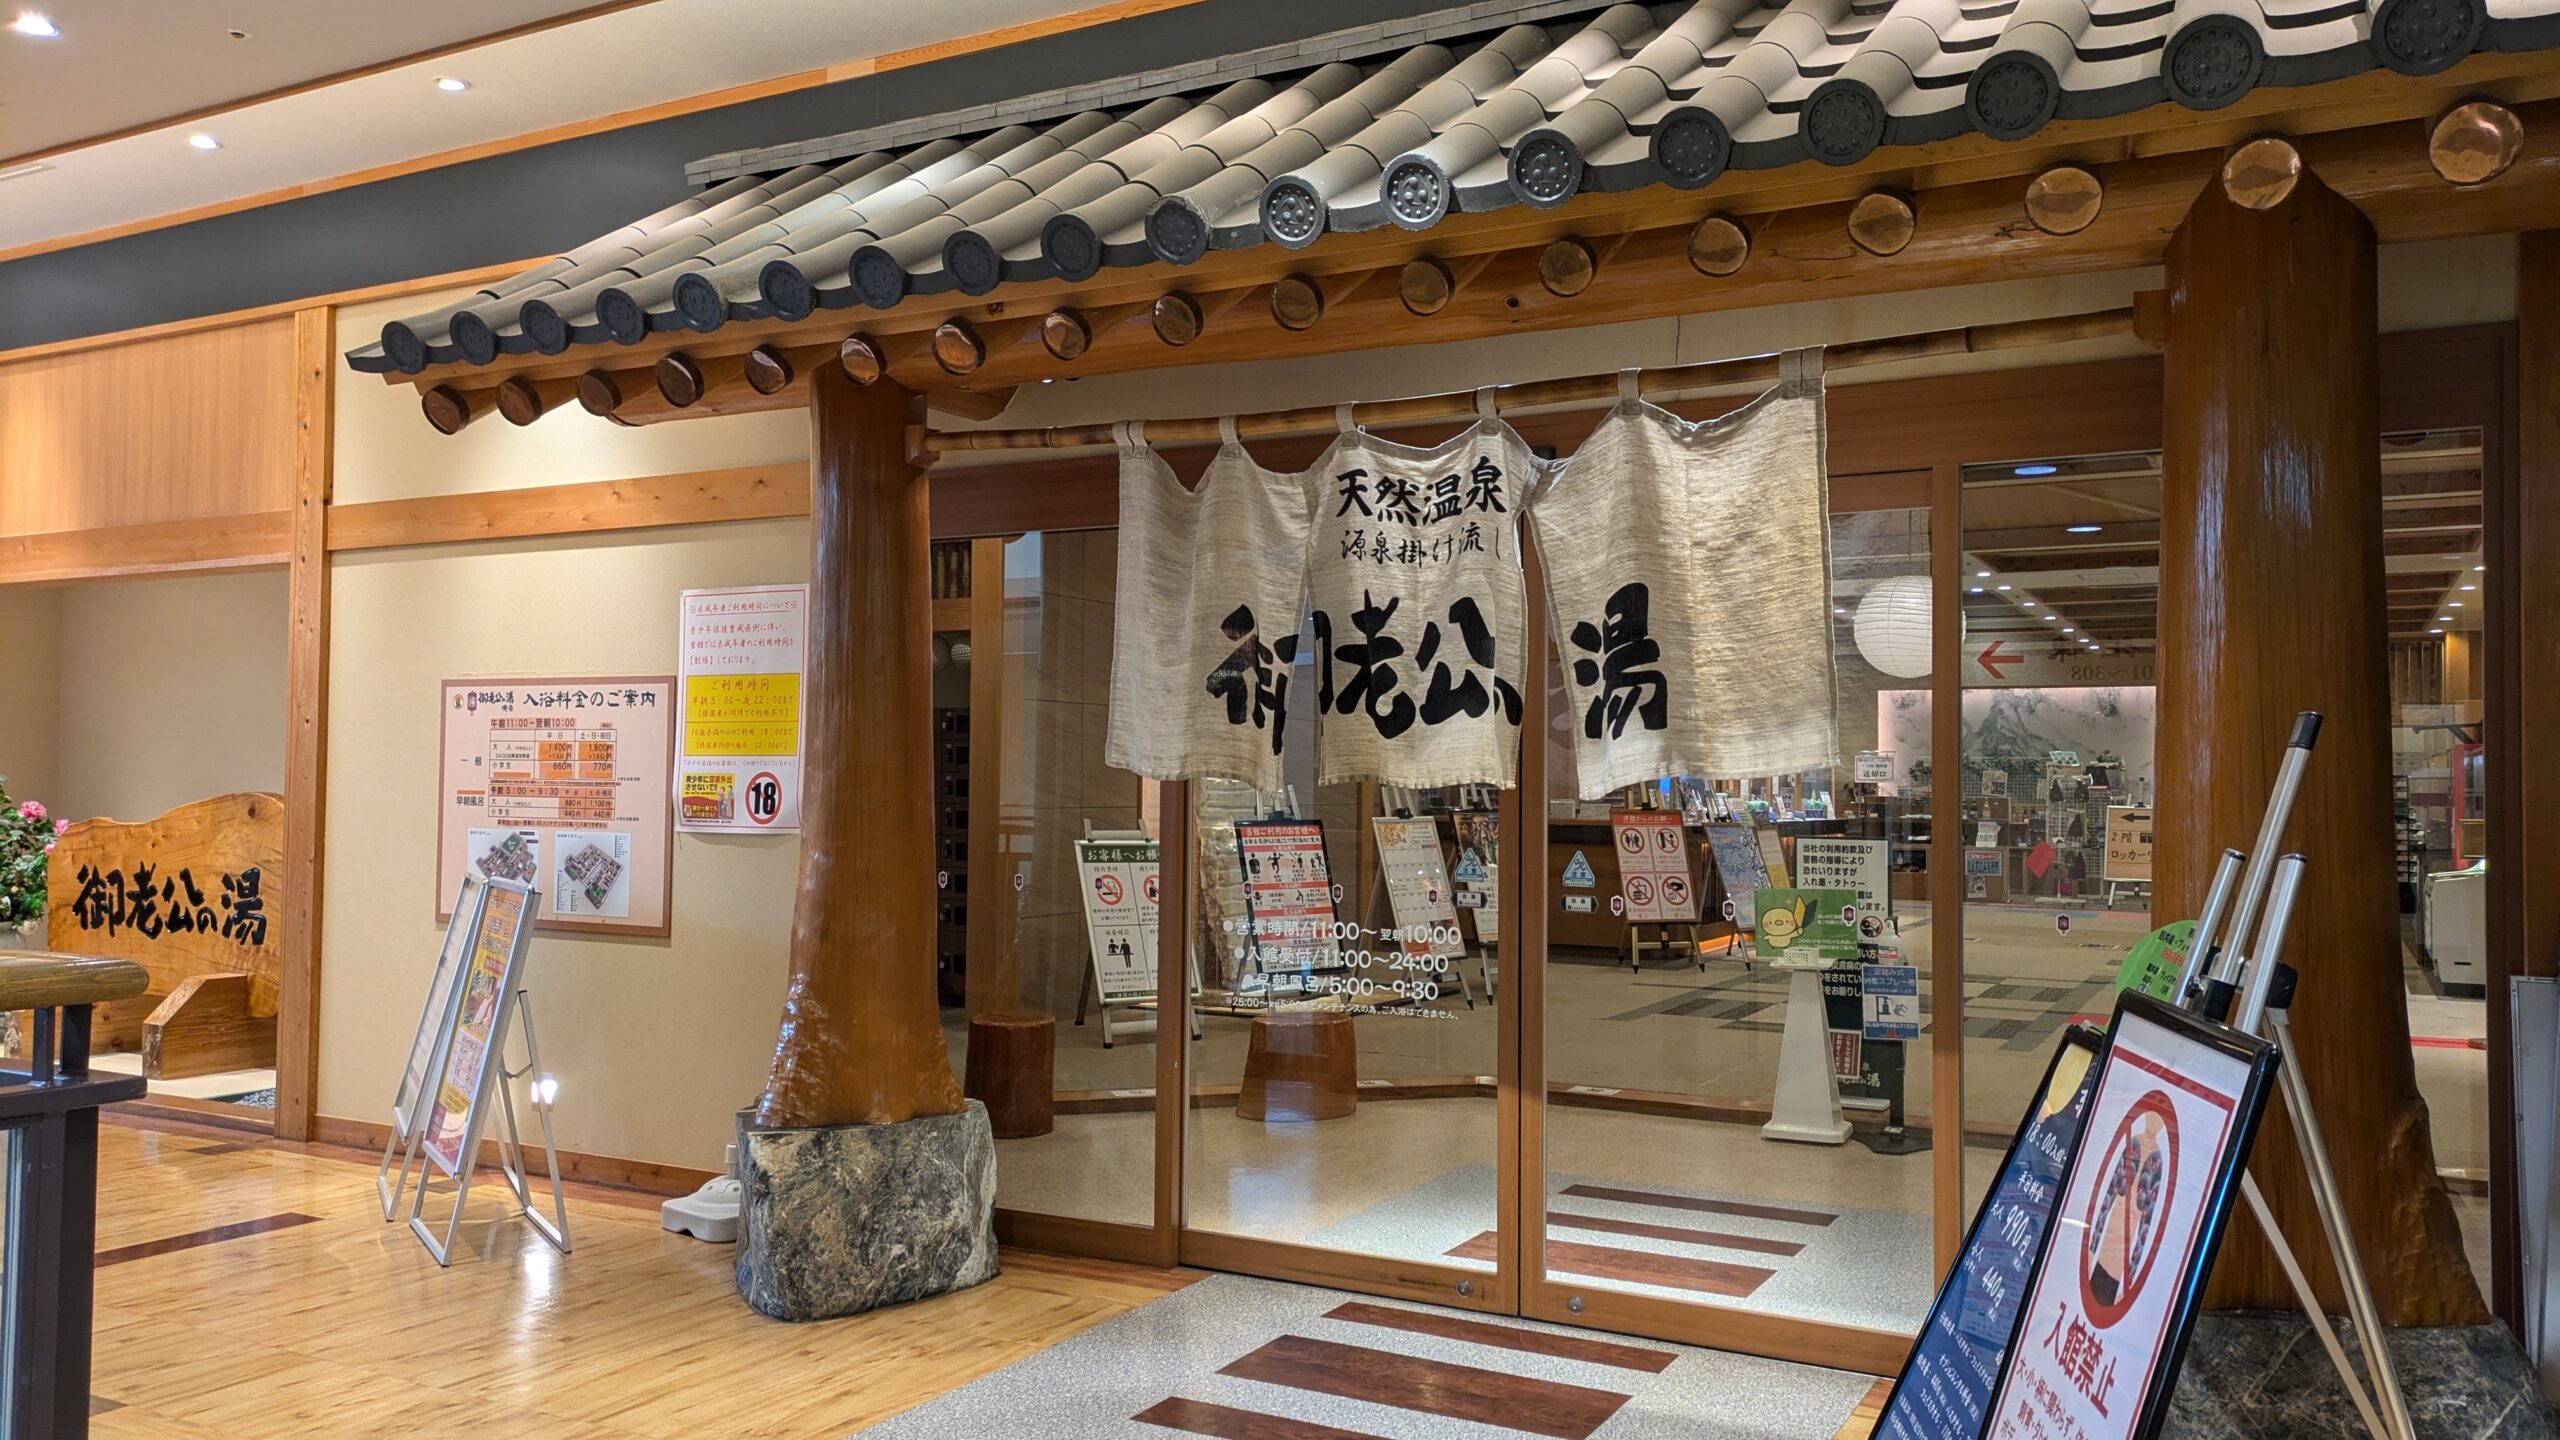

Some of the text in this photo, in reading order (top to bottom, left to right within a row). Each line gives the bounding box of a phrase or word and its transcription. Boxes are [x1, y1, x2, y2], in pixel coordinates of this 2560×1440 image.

[1336, 456, 1508, 526] 天然温泉
[1341, 521, 1501, 568] 源泉掛け流し
[712, 677, 769, 692] ご利用時間
[523, 688, 656, 710] 入浴料金のご案内
[491, 761, 512, 770] 小学生
[456, 796, 484, 807] 早朝風呂
[751, 781, 777, 816] 18
[1088, 848, 1159, 862] お客様へお願
[1803, 843, 1873, 855] 当社の利用約款及び
[1803, 855, 1865, 866] 警察の指導により
[1803, 866, 1857, 877] 恐れいりますが
[1803, 877, 1866, 888] 入れ墨・タトゥー
[1857, 890, 1873, 900] 館は
[72, 861, 269, 946] 御老公の湯
[1857, 902, 1886, 912] します。
[2018, 1170, 2045, 1204] 平日料金
[2001, 1204, 2032, 1258] 990円
[1982, 1265, 2005, 1309] 440円
[2043, 1300, 2117, 1420] 入館禁止
